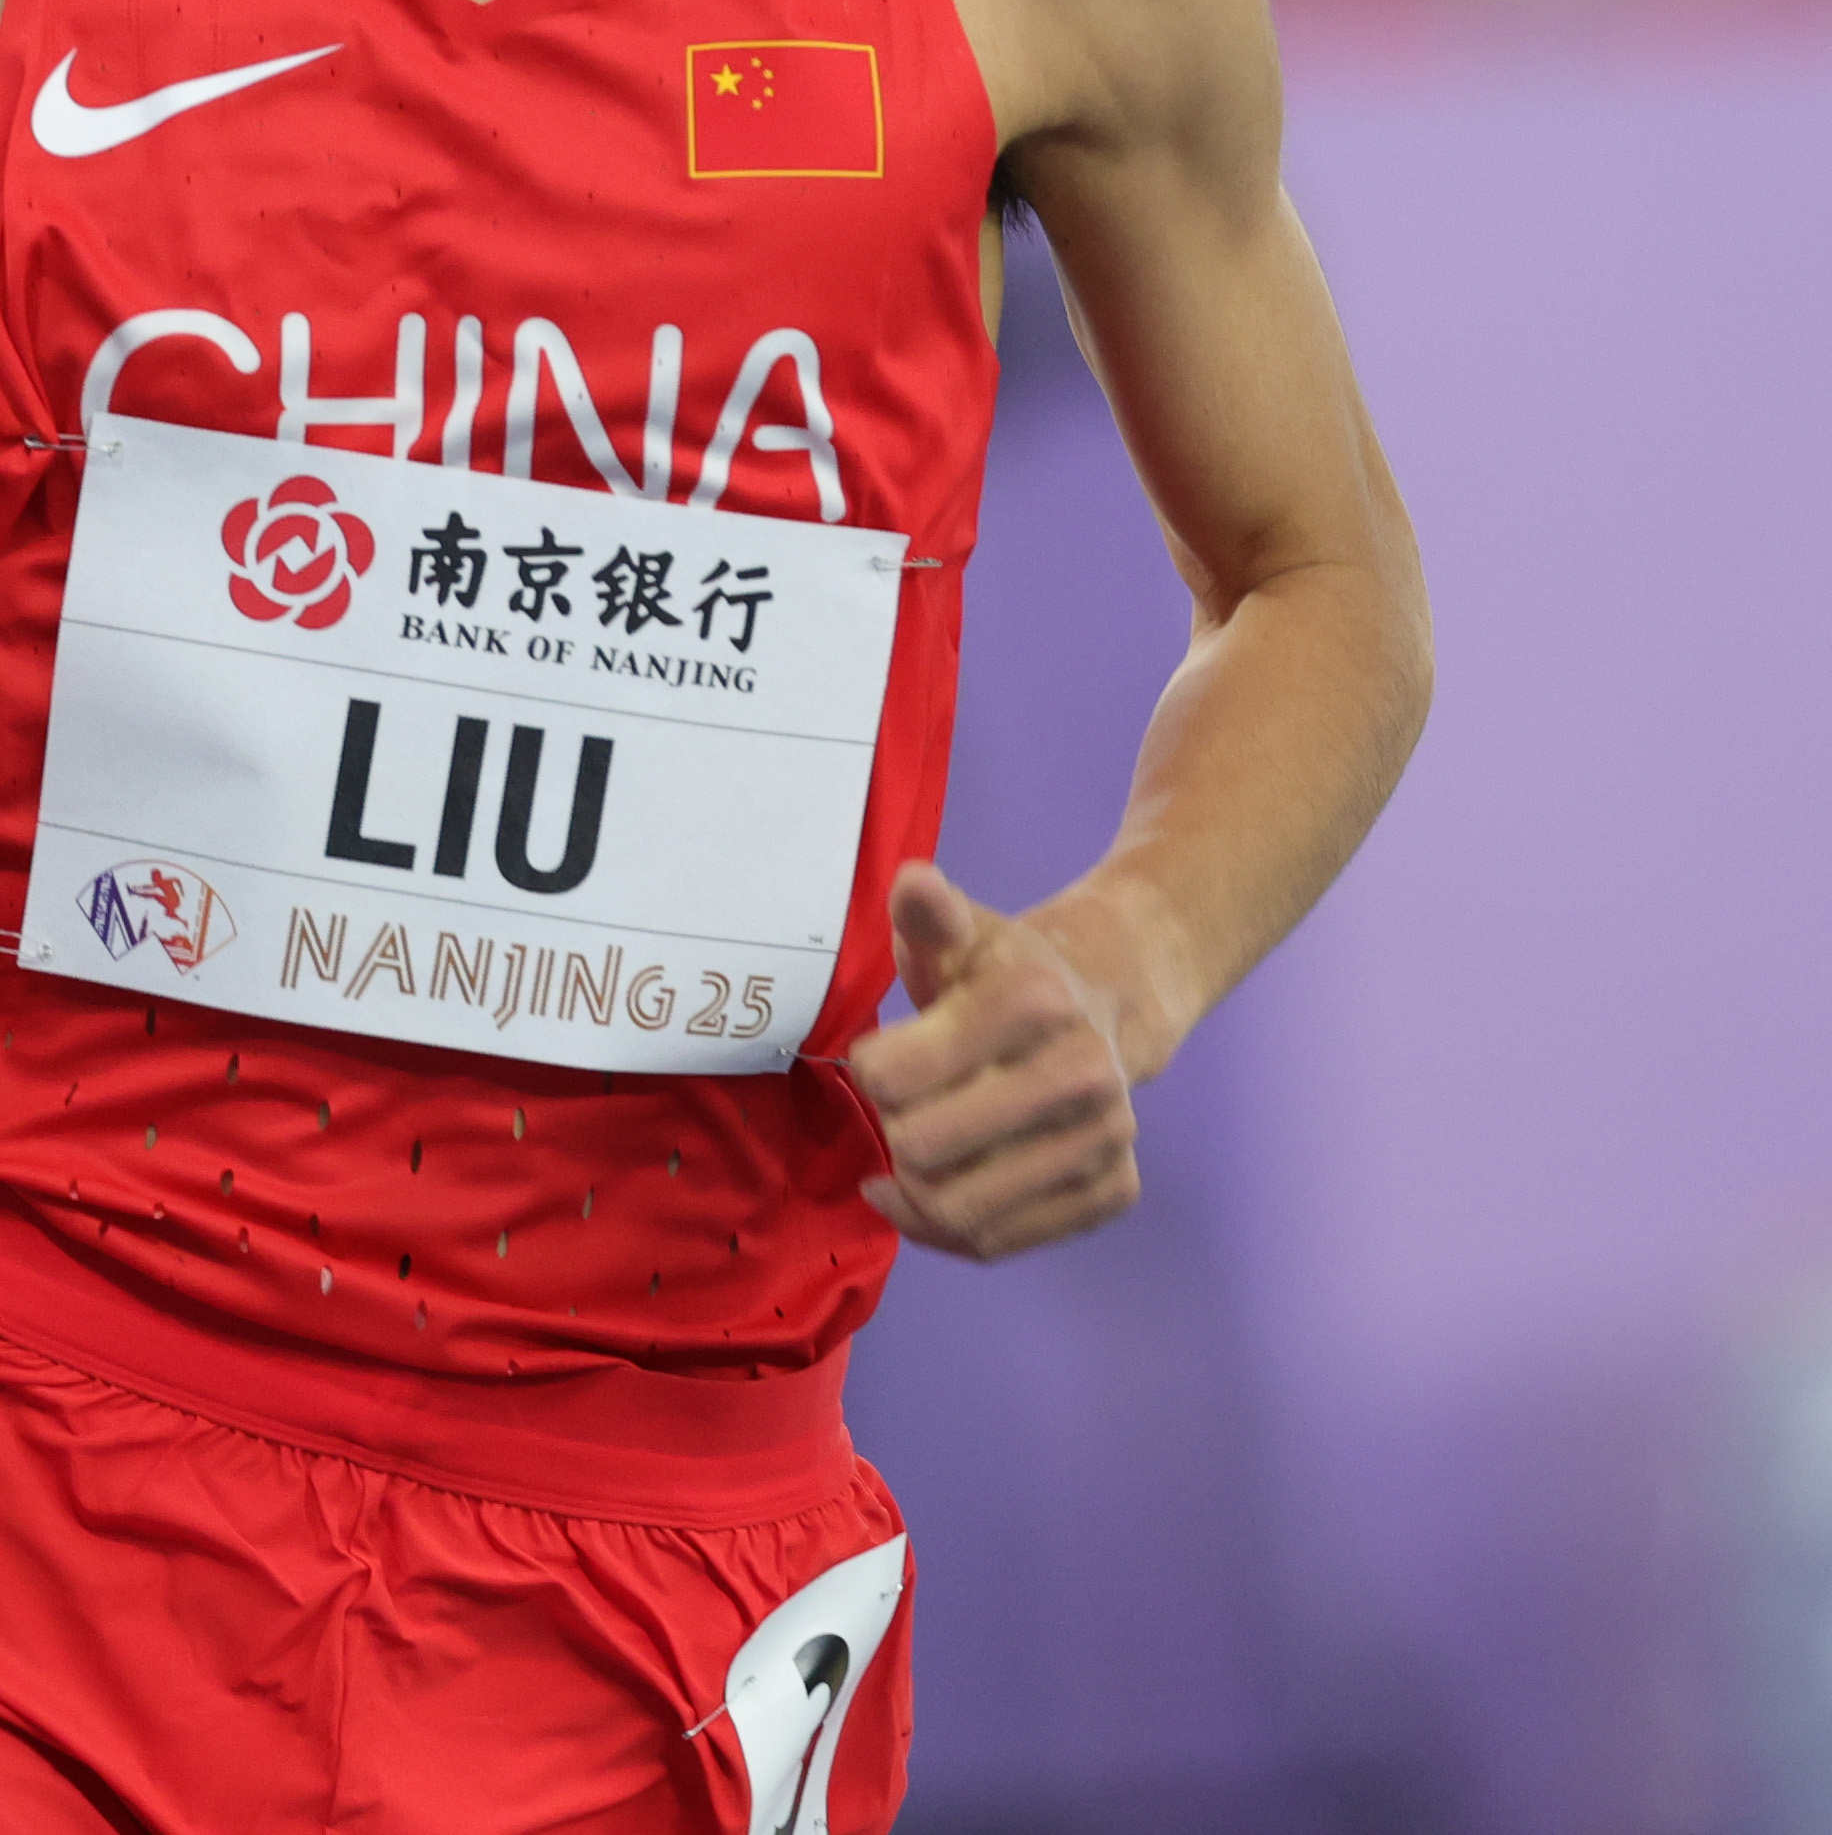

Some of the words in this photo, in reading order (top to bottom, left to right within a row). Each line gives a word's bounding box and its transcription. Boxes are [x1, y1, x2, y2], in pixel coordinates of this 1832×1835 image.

[80, 308, 847, 523] CHINA
[399, 613, 513, 656] BANK
[527, 635, 575, 666] OF
[589, 644, 758, 693] NANJING
[407, 510, 775, 653] 南京銀行
[325, 697, 615, 895] LIU
[279, 906, 676, 1031] NANJING
[685, 970, 775, 1039] 25
